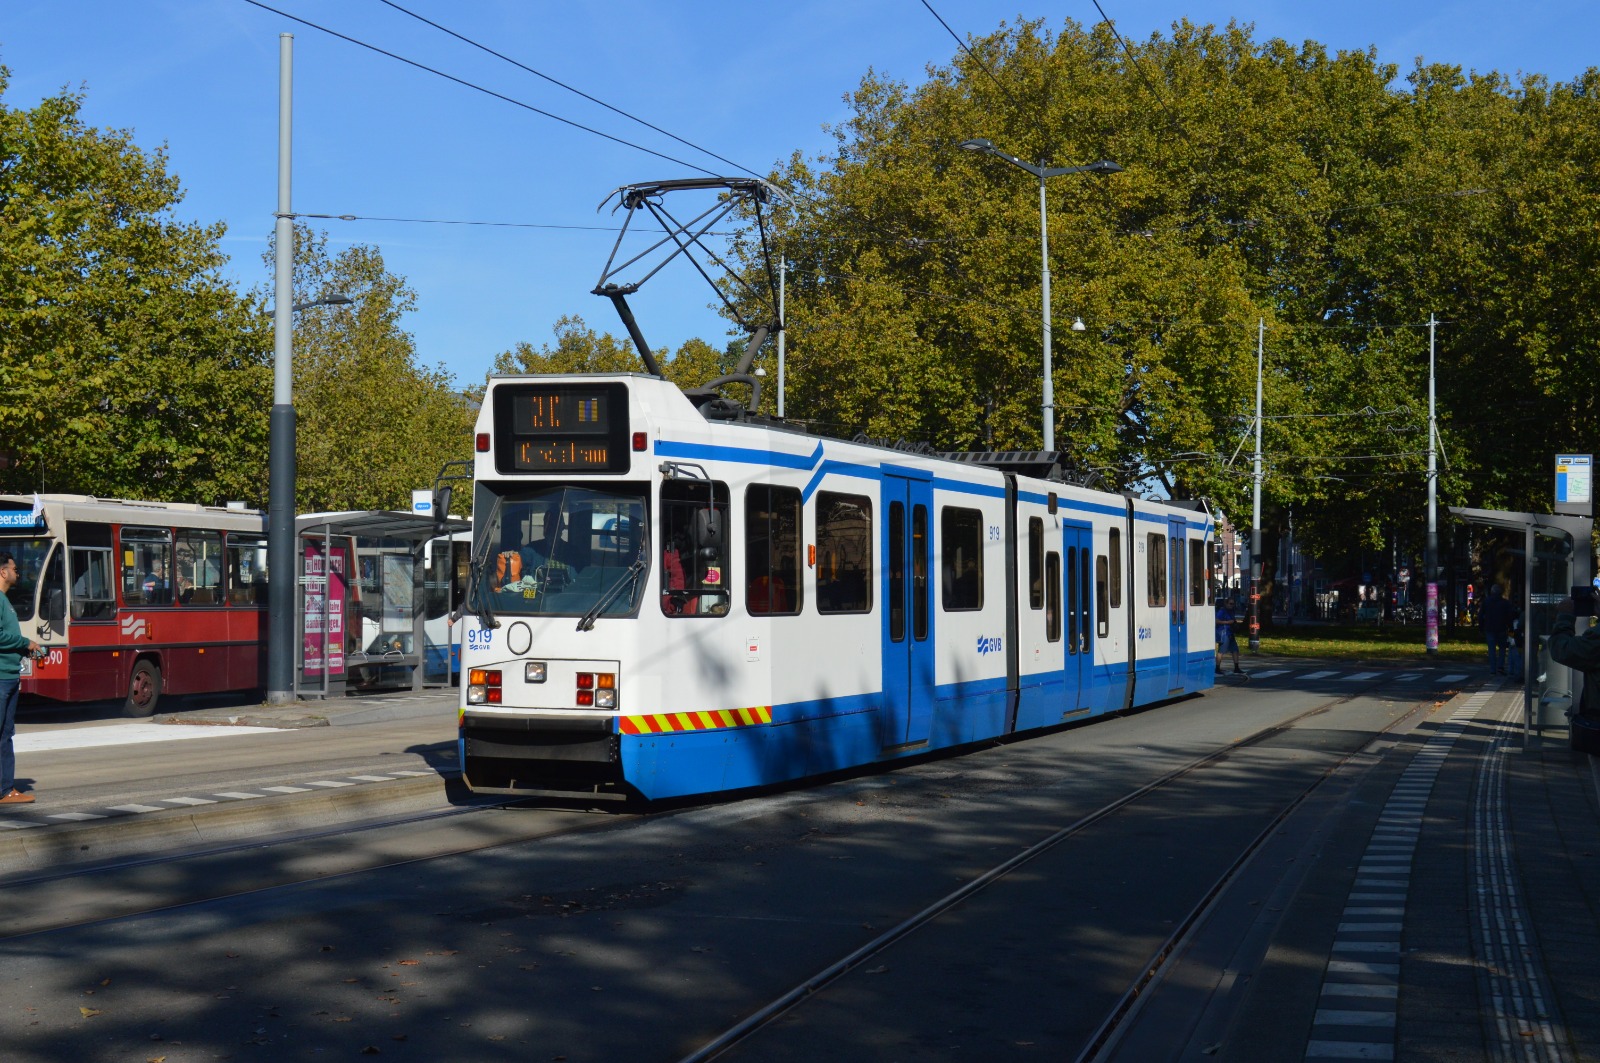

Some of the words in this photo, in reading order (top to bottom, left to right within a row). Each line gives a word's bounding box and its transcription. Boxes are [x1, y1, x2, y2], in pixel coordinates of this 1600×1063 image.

[989, 525, 1000, 540] 919
[468, 629, 492, 643] 919
[989, 637, 1002, 652] GVB
